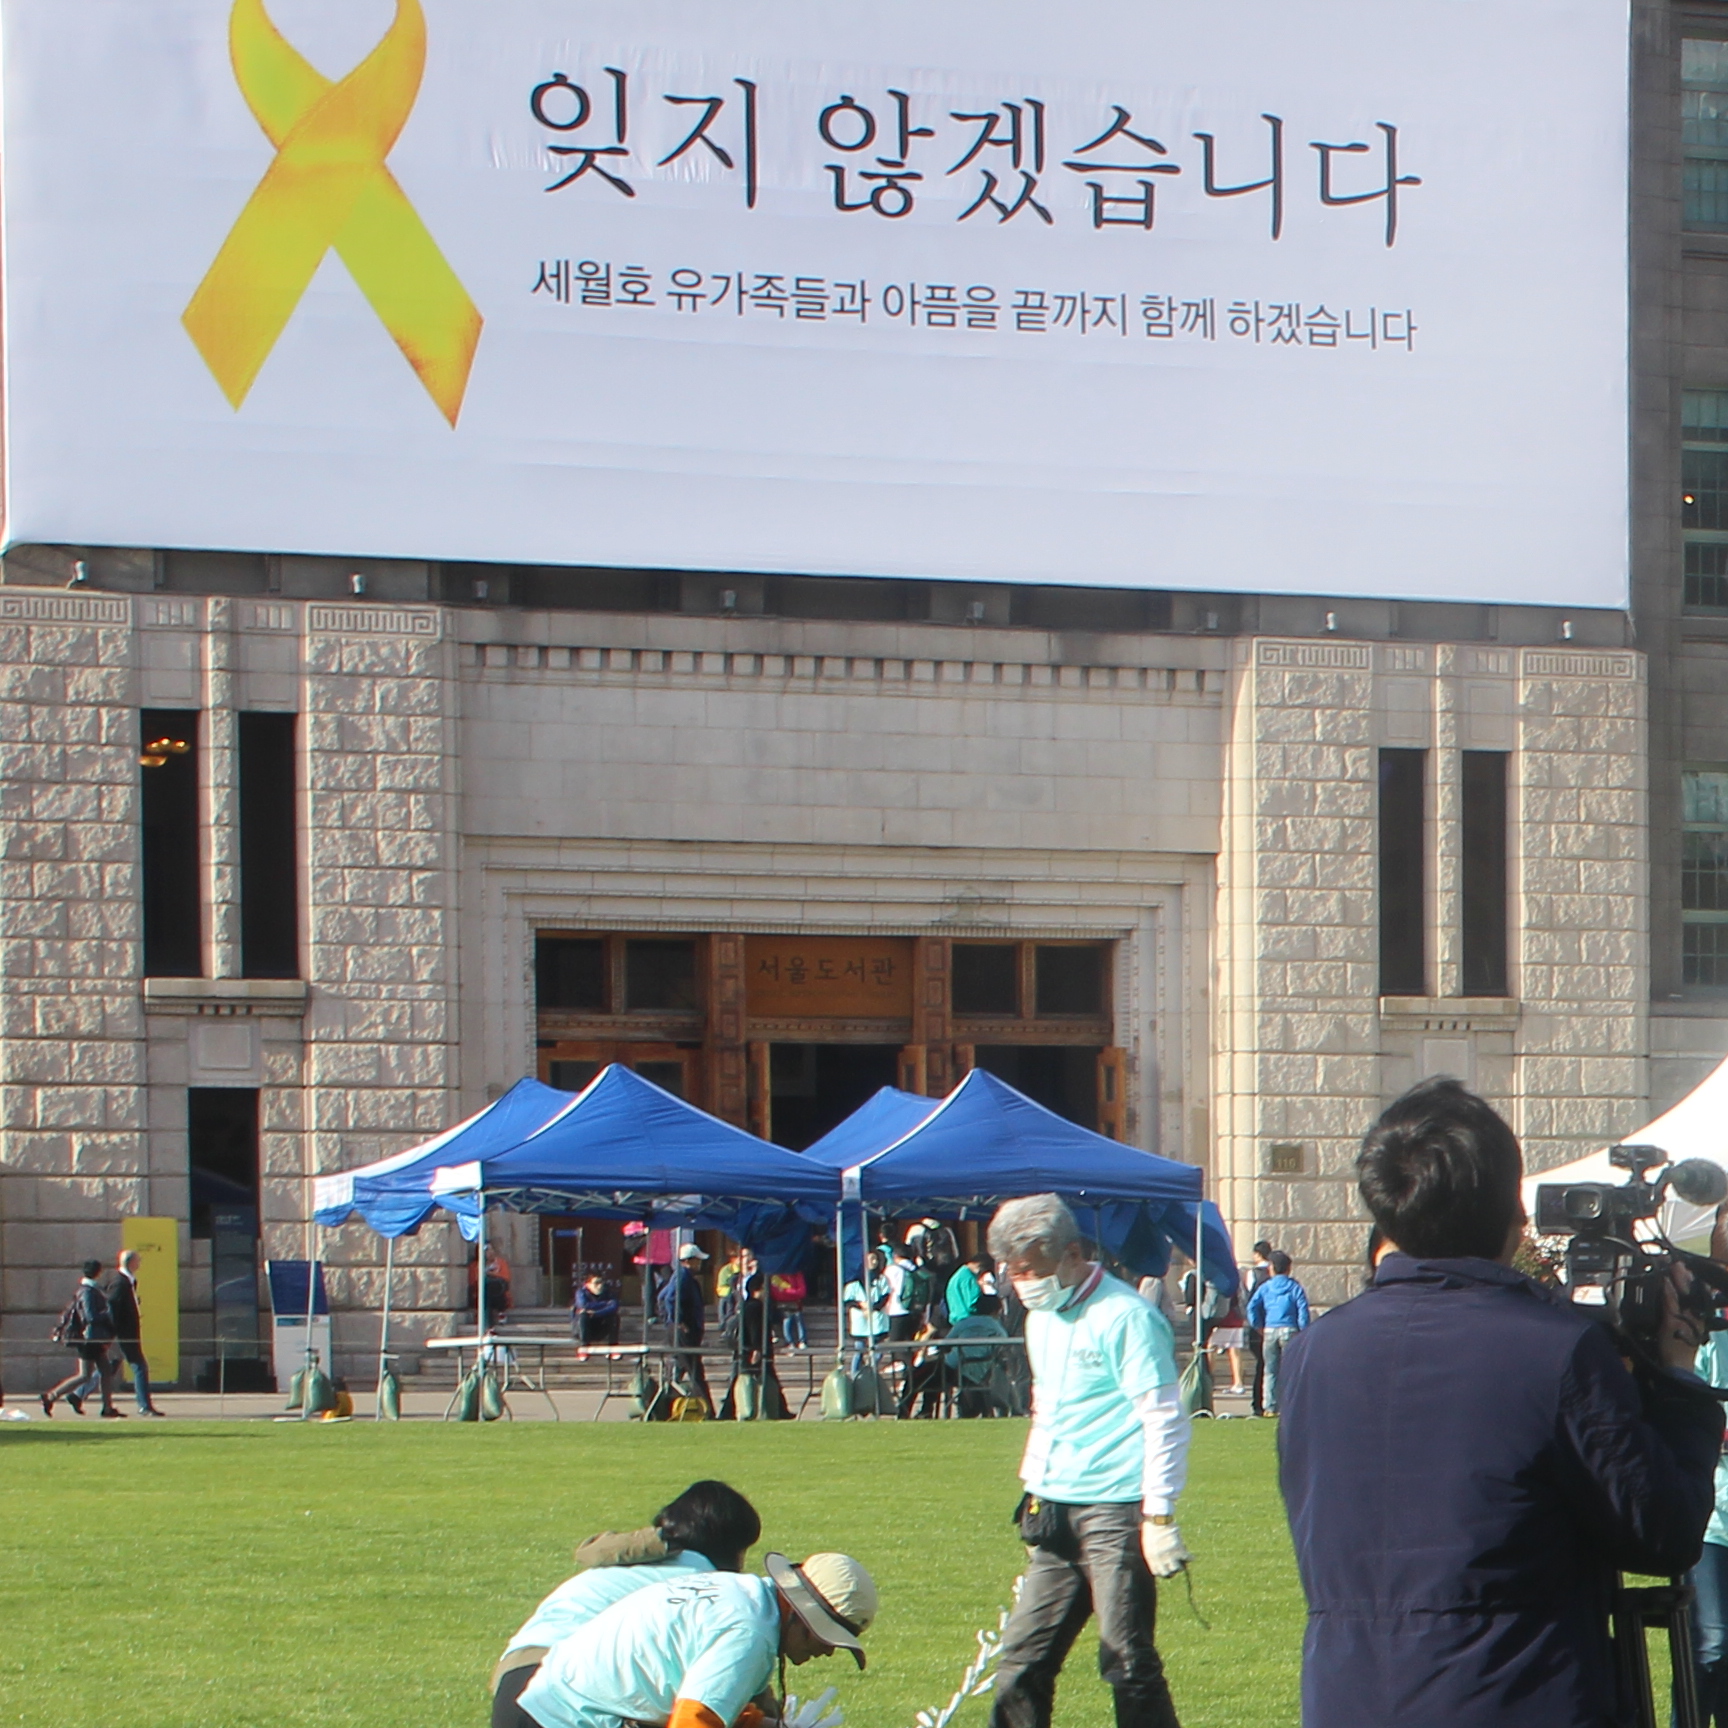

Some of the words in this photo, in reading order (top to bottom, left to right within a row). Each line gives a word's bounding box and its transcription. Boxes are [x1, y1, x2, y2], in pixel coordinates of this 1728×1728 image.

[529, 66, 759, 211] 잊지
[816, 87, 1423, 249] 않겠습니다
[529, 258, 656, 308] 세월호
[665, 267, 872, 325] 유가족들과
[881, 281, 1002, 331] 아픔을
[1010, 288, 1128, 337] 끝까지
[1139, 292, 1216, 342] 함께
[1226, 299, 1419, 352] 하겠습니다
